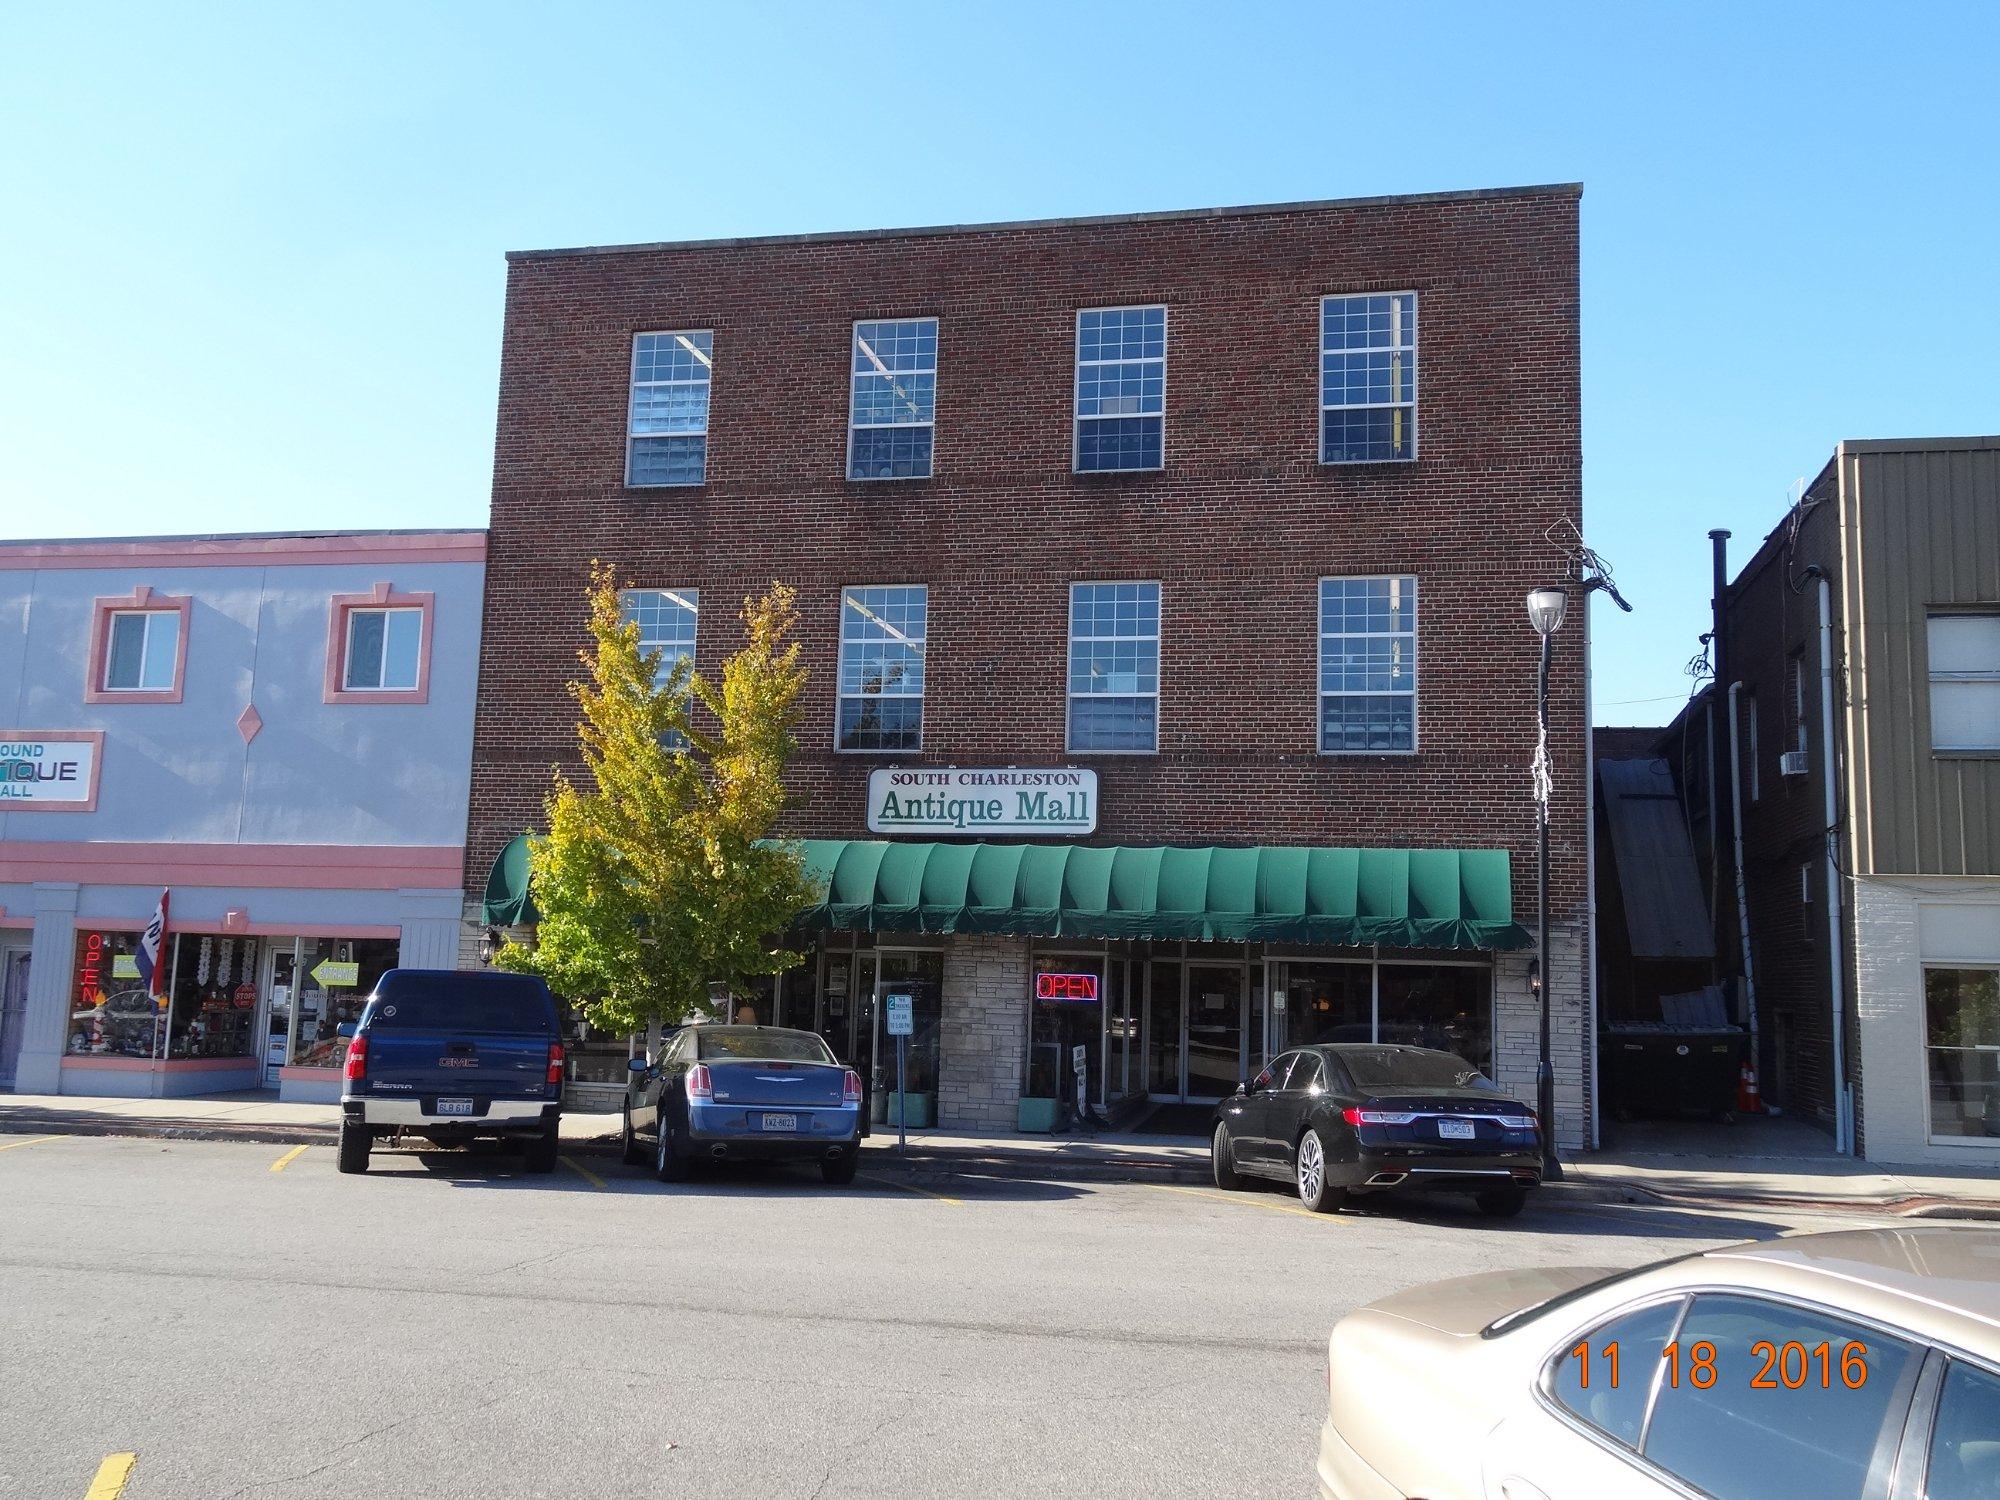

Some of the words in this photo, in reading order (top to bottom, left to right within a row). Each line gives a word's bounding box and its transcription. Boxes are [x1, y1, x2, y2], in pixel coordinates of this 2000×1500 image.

[890, 773, 949, 786] SOUTH
[958, 773, 1081, 786] CHARLESTON
[878, 791, 1003, 828] Antique
[1015, 791, 1089, 821] Mall
[82, 934, 101, 1003] OPEN
[1039, 975, 1097, 999] OPEN
[889, 998, 895, 1008] 2
[438, 1057, 480, 1068] GMC
